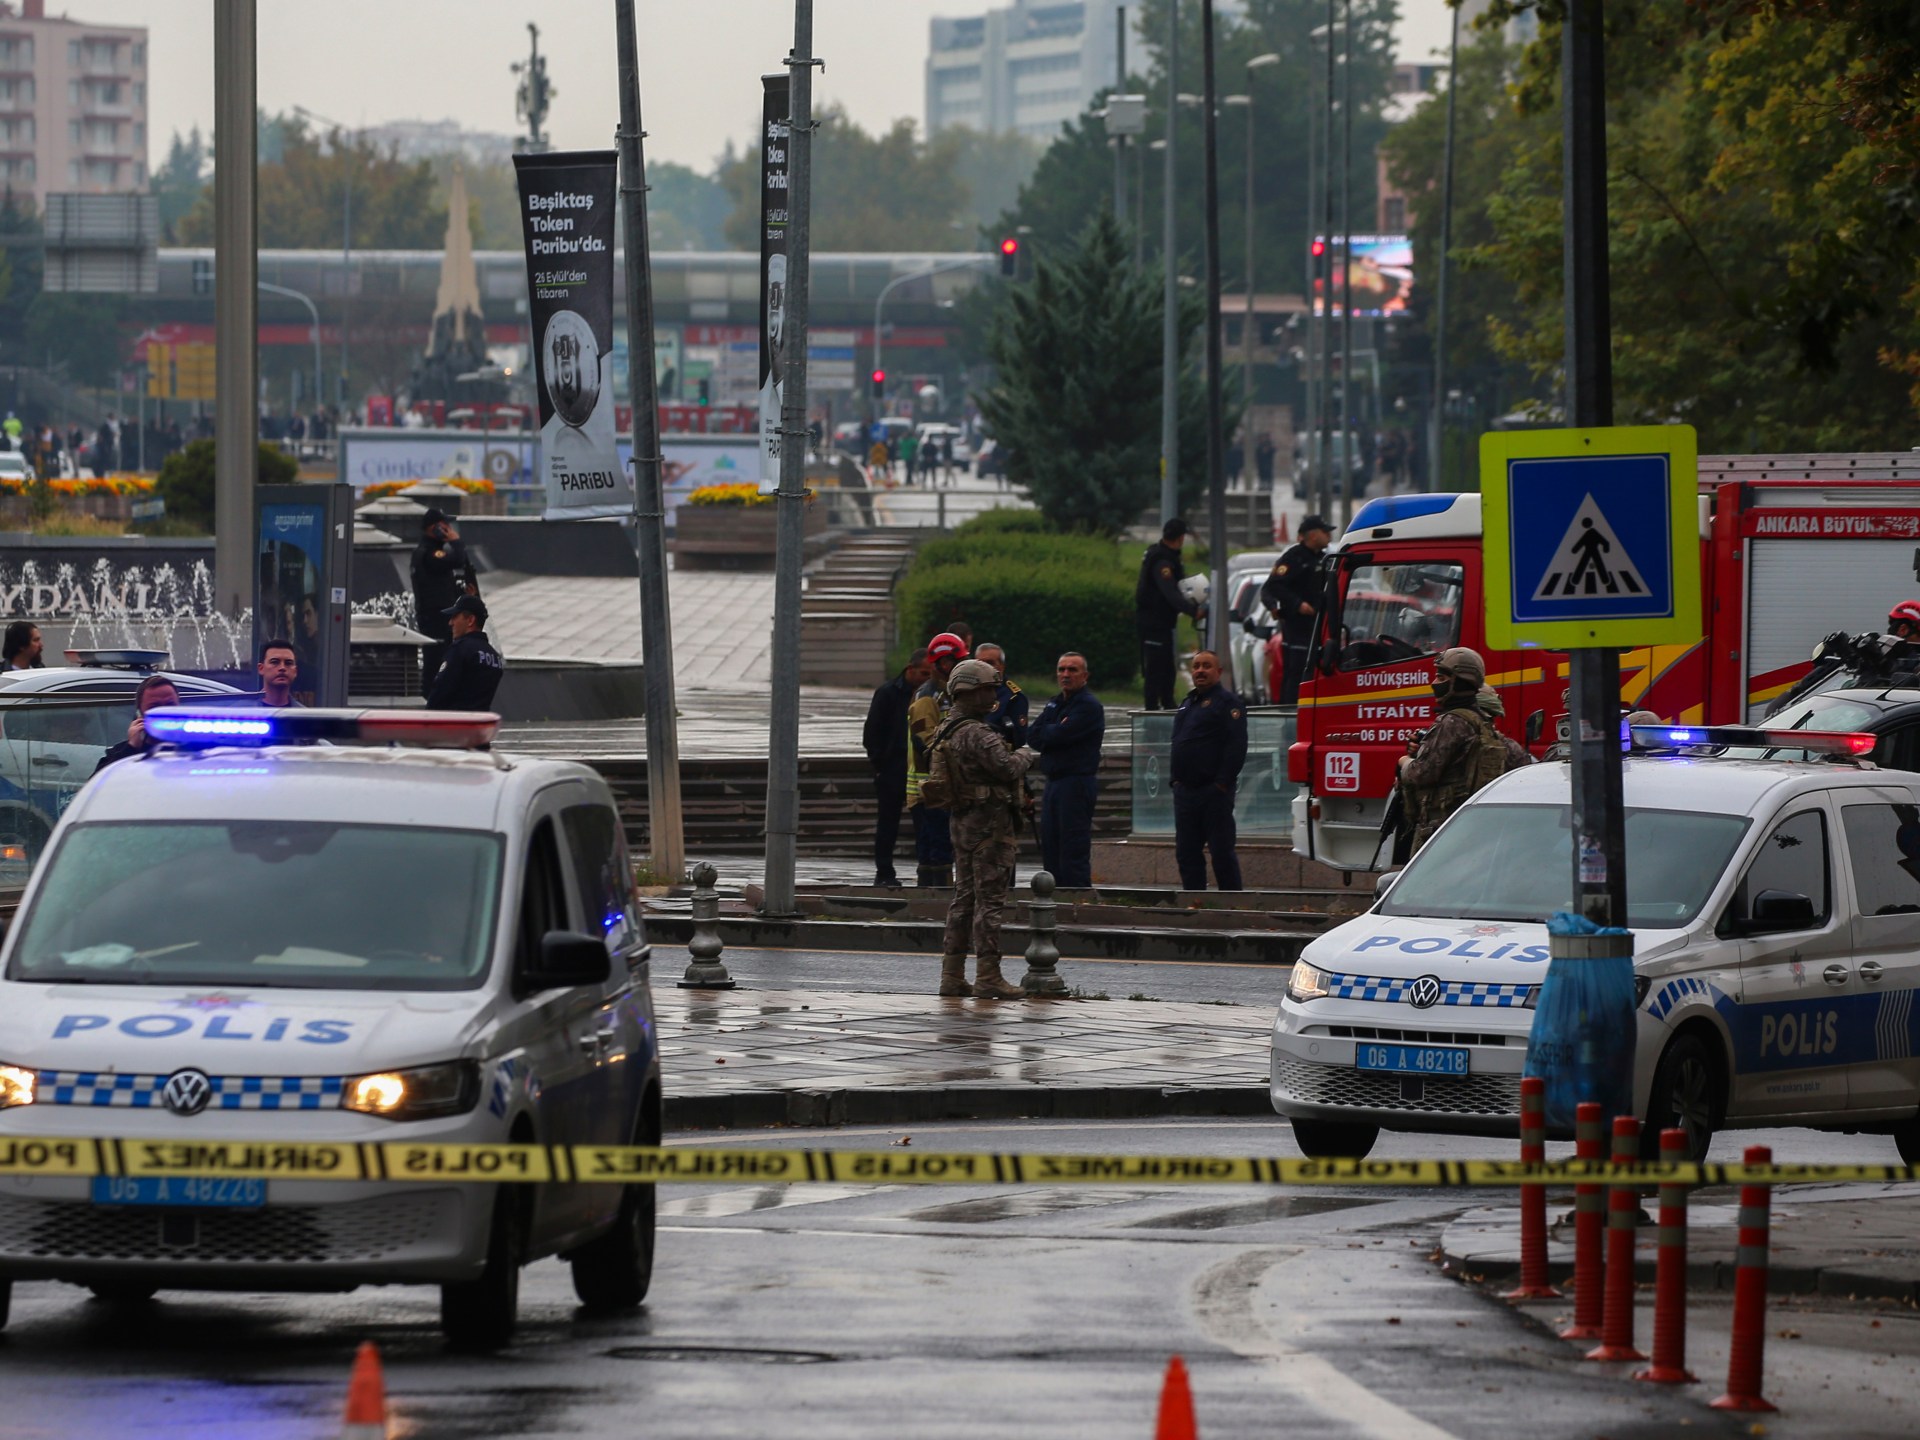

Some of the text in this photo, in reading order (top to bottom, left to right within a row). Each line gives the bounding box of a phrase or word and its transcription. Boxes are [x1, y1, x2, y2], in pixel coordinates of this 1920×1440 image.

[528, 191, 594, 212] Beşiktaş
[529, 214, 574, 233] Token
[531, 234, 606, 255] Paribu'da.
[1756, 515, 1820, 534] ANKARA
[0, 583, 151, 615] YDANI
[1356, 669, 1430, 688] BÜYÜKŞEHİR
[1357, 703, 1431, 719] İTFAİYE
[1360, 729, 1375, 741] 06
[1378, 729, 1394, 741] DF
[1330, 756, 1354, 775] 112
[1367, 1046, 1466, 1072] 06 A 48218
